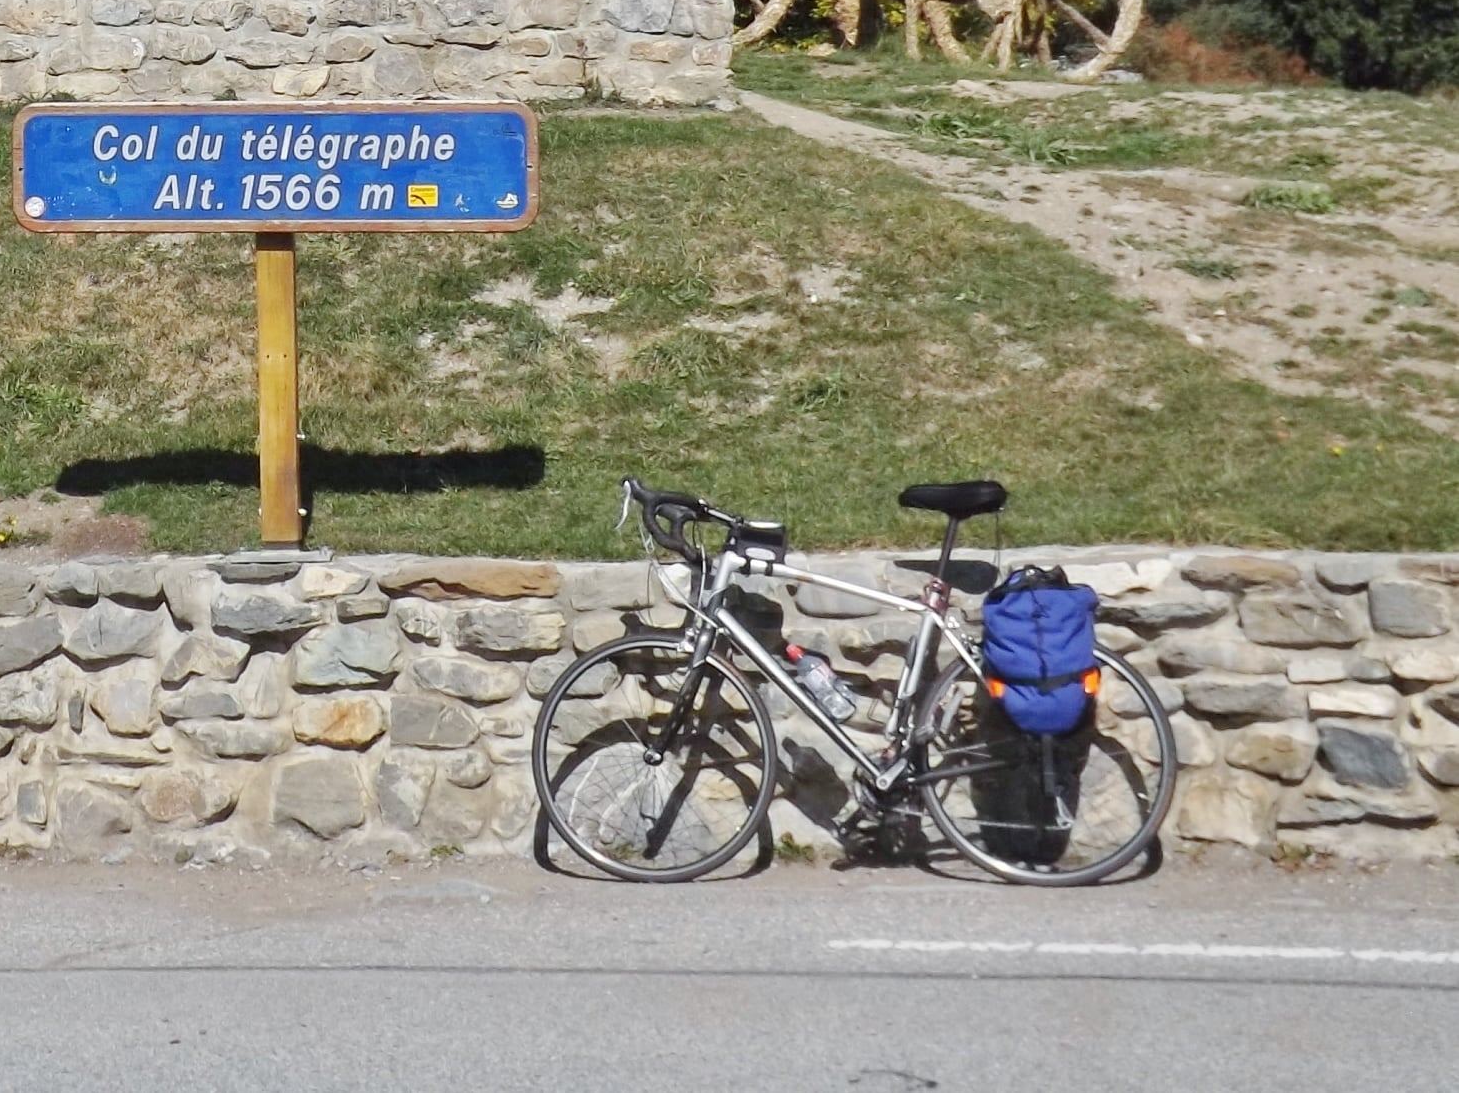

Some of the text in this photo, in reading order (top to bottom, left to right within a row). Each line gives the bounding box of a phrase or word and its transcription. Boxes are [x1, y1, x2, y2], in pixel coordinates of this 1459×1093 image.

[93, 122, 455, 170] Col du télégraphe
[154, 174, 395, 211] Alt. 1566 m
